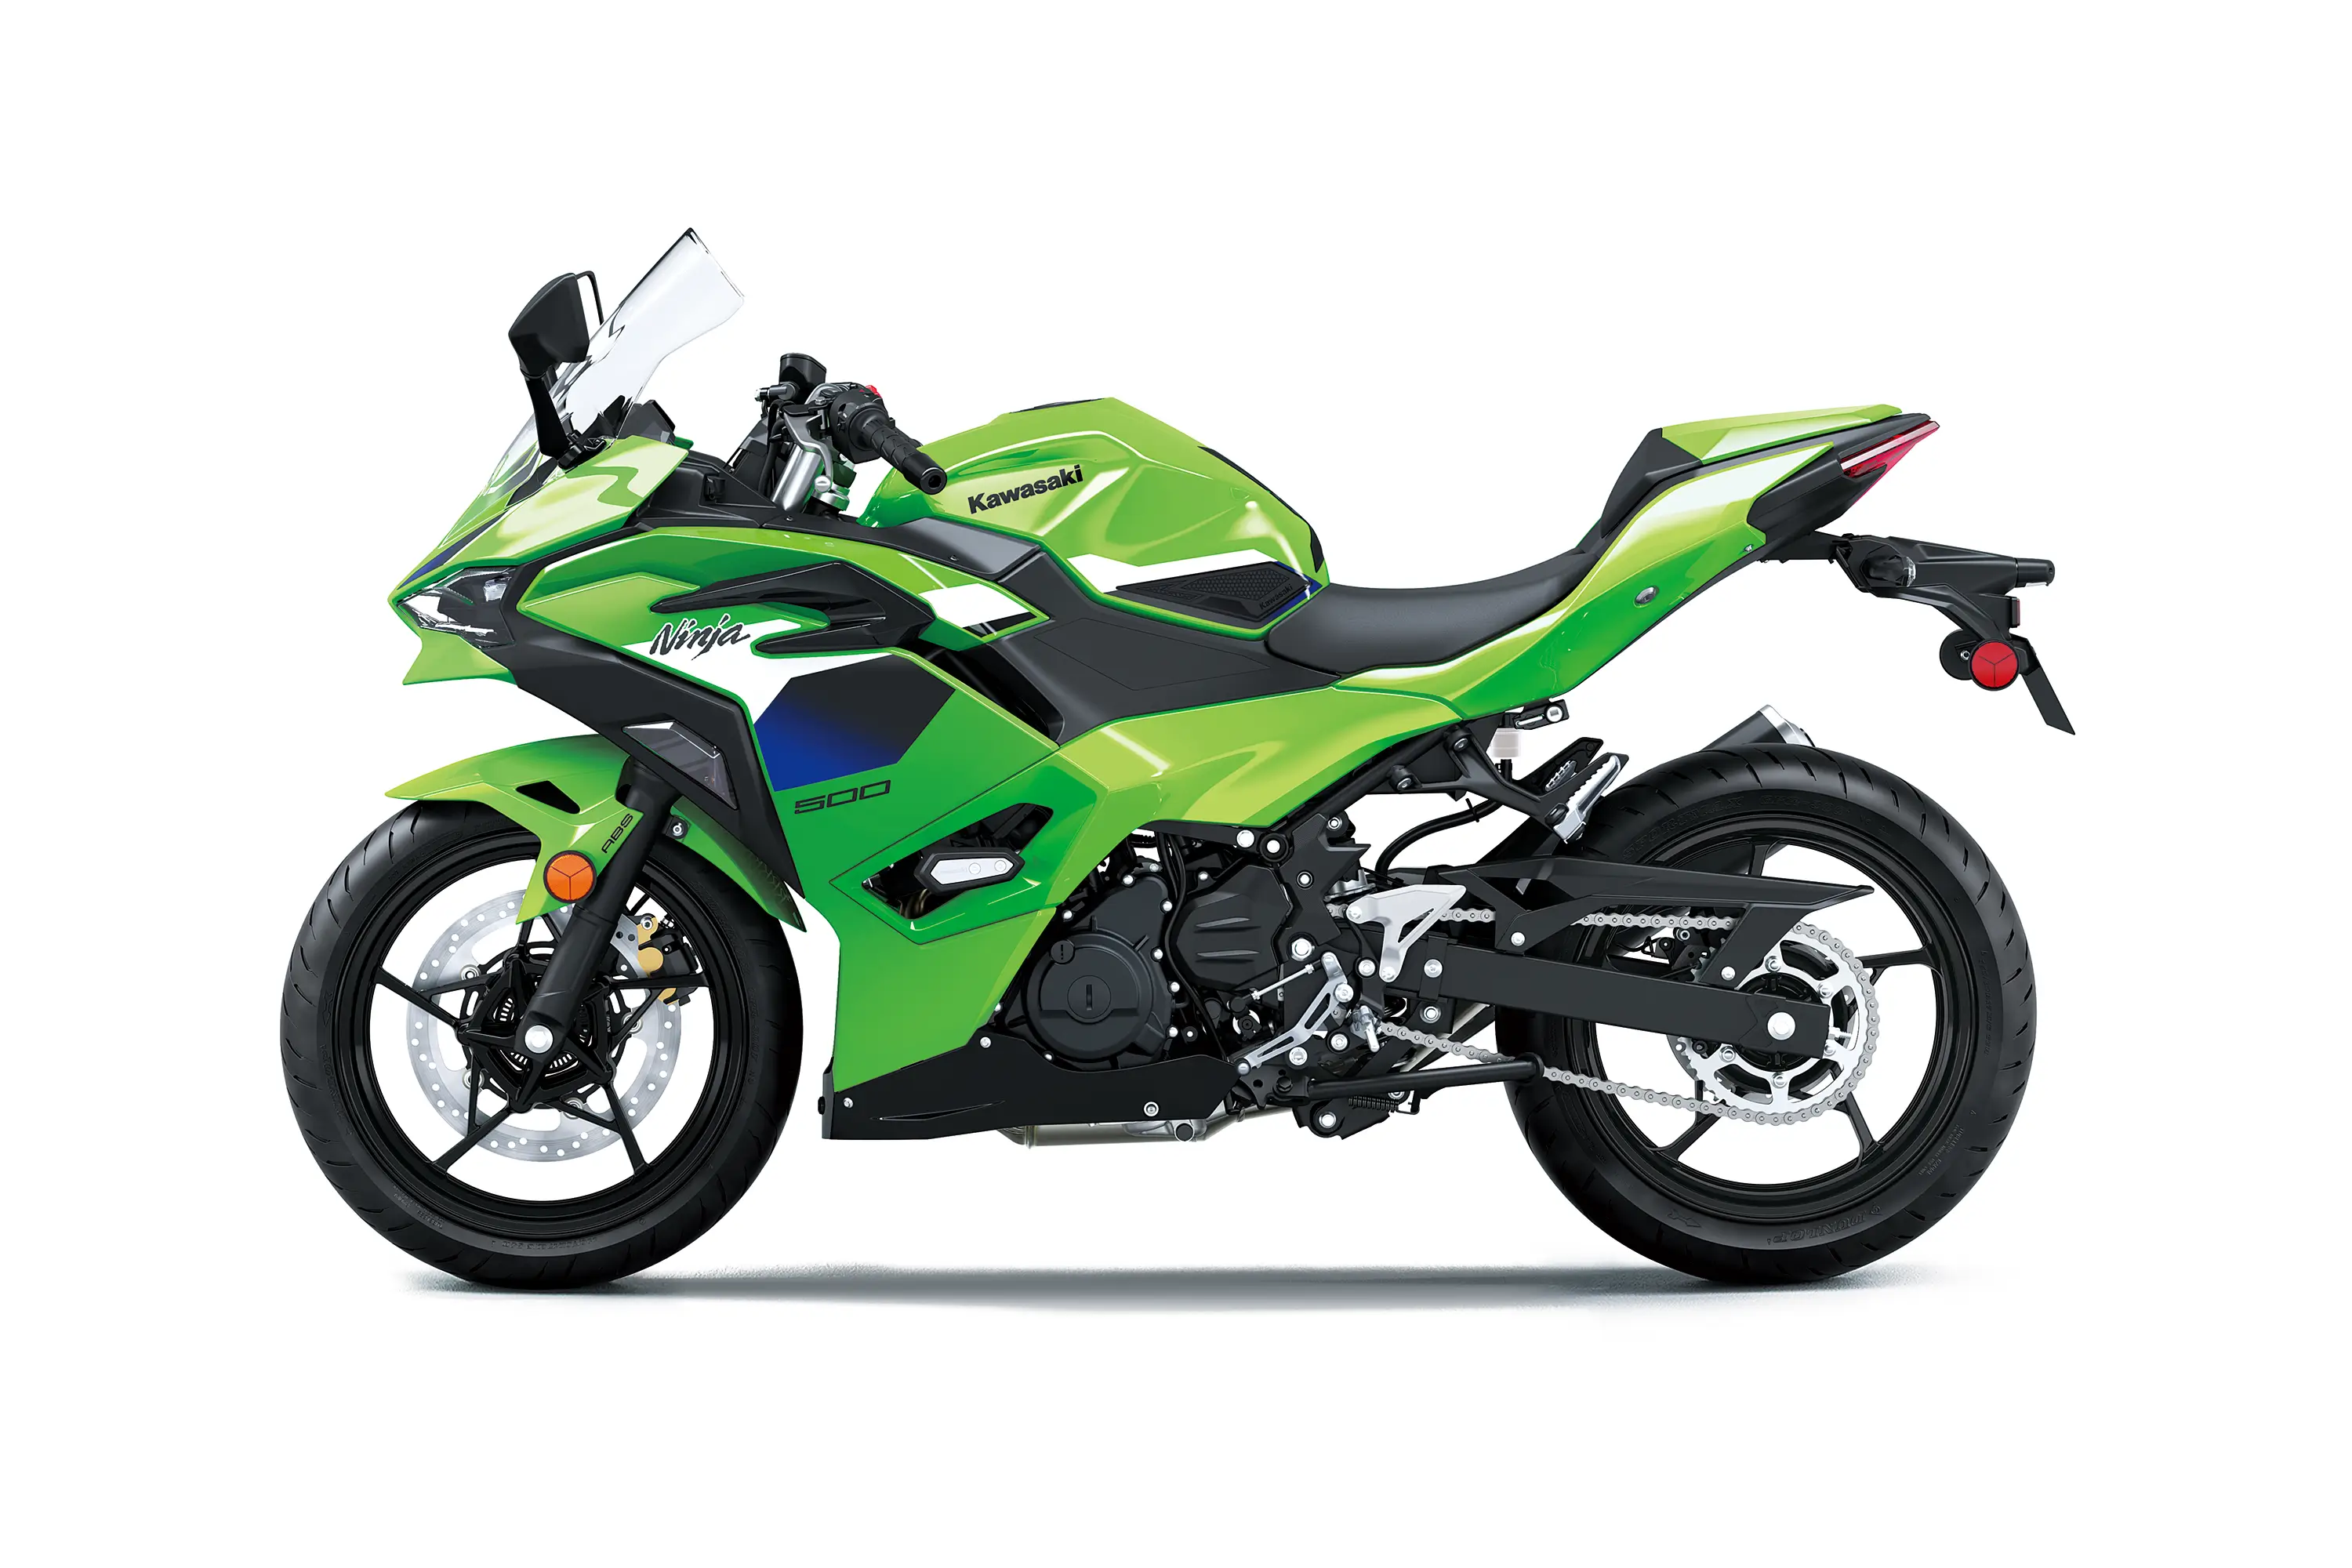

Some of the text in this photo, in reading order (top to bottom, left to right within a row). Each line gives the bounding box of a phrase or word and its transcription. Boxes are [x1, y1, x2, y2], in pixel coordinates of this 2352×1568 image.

[967, 464, 1083, 514] Kawasaki
[1259, 583, 1294, 610] Kawasaki
[649, 615, 751, 661] Ninja
[794, 779, 891, 815] 500
[601, 813, 633, 854] ABS
[1773, 1210, 1867, 1243] DUNLOP
